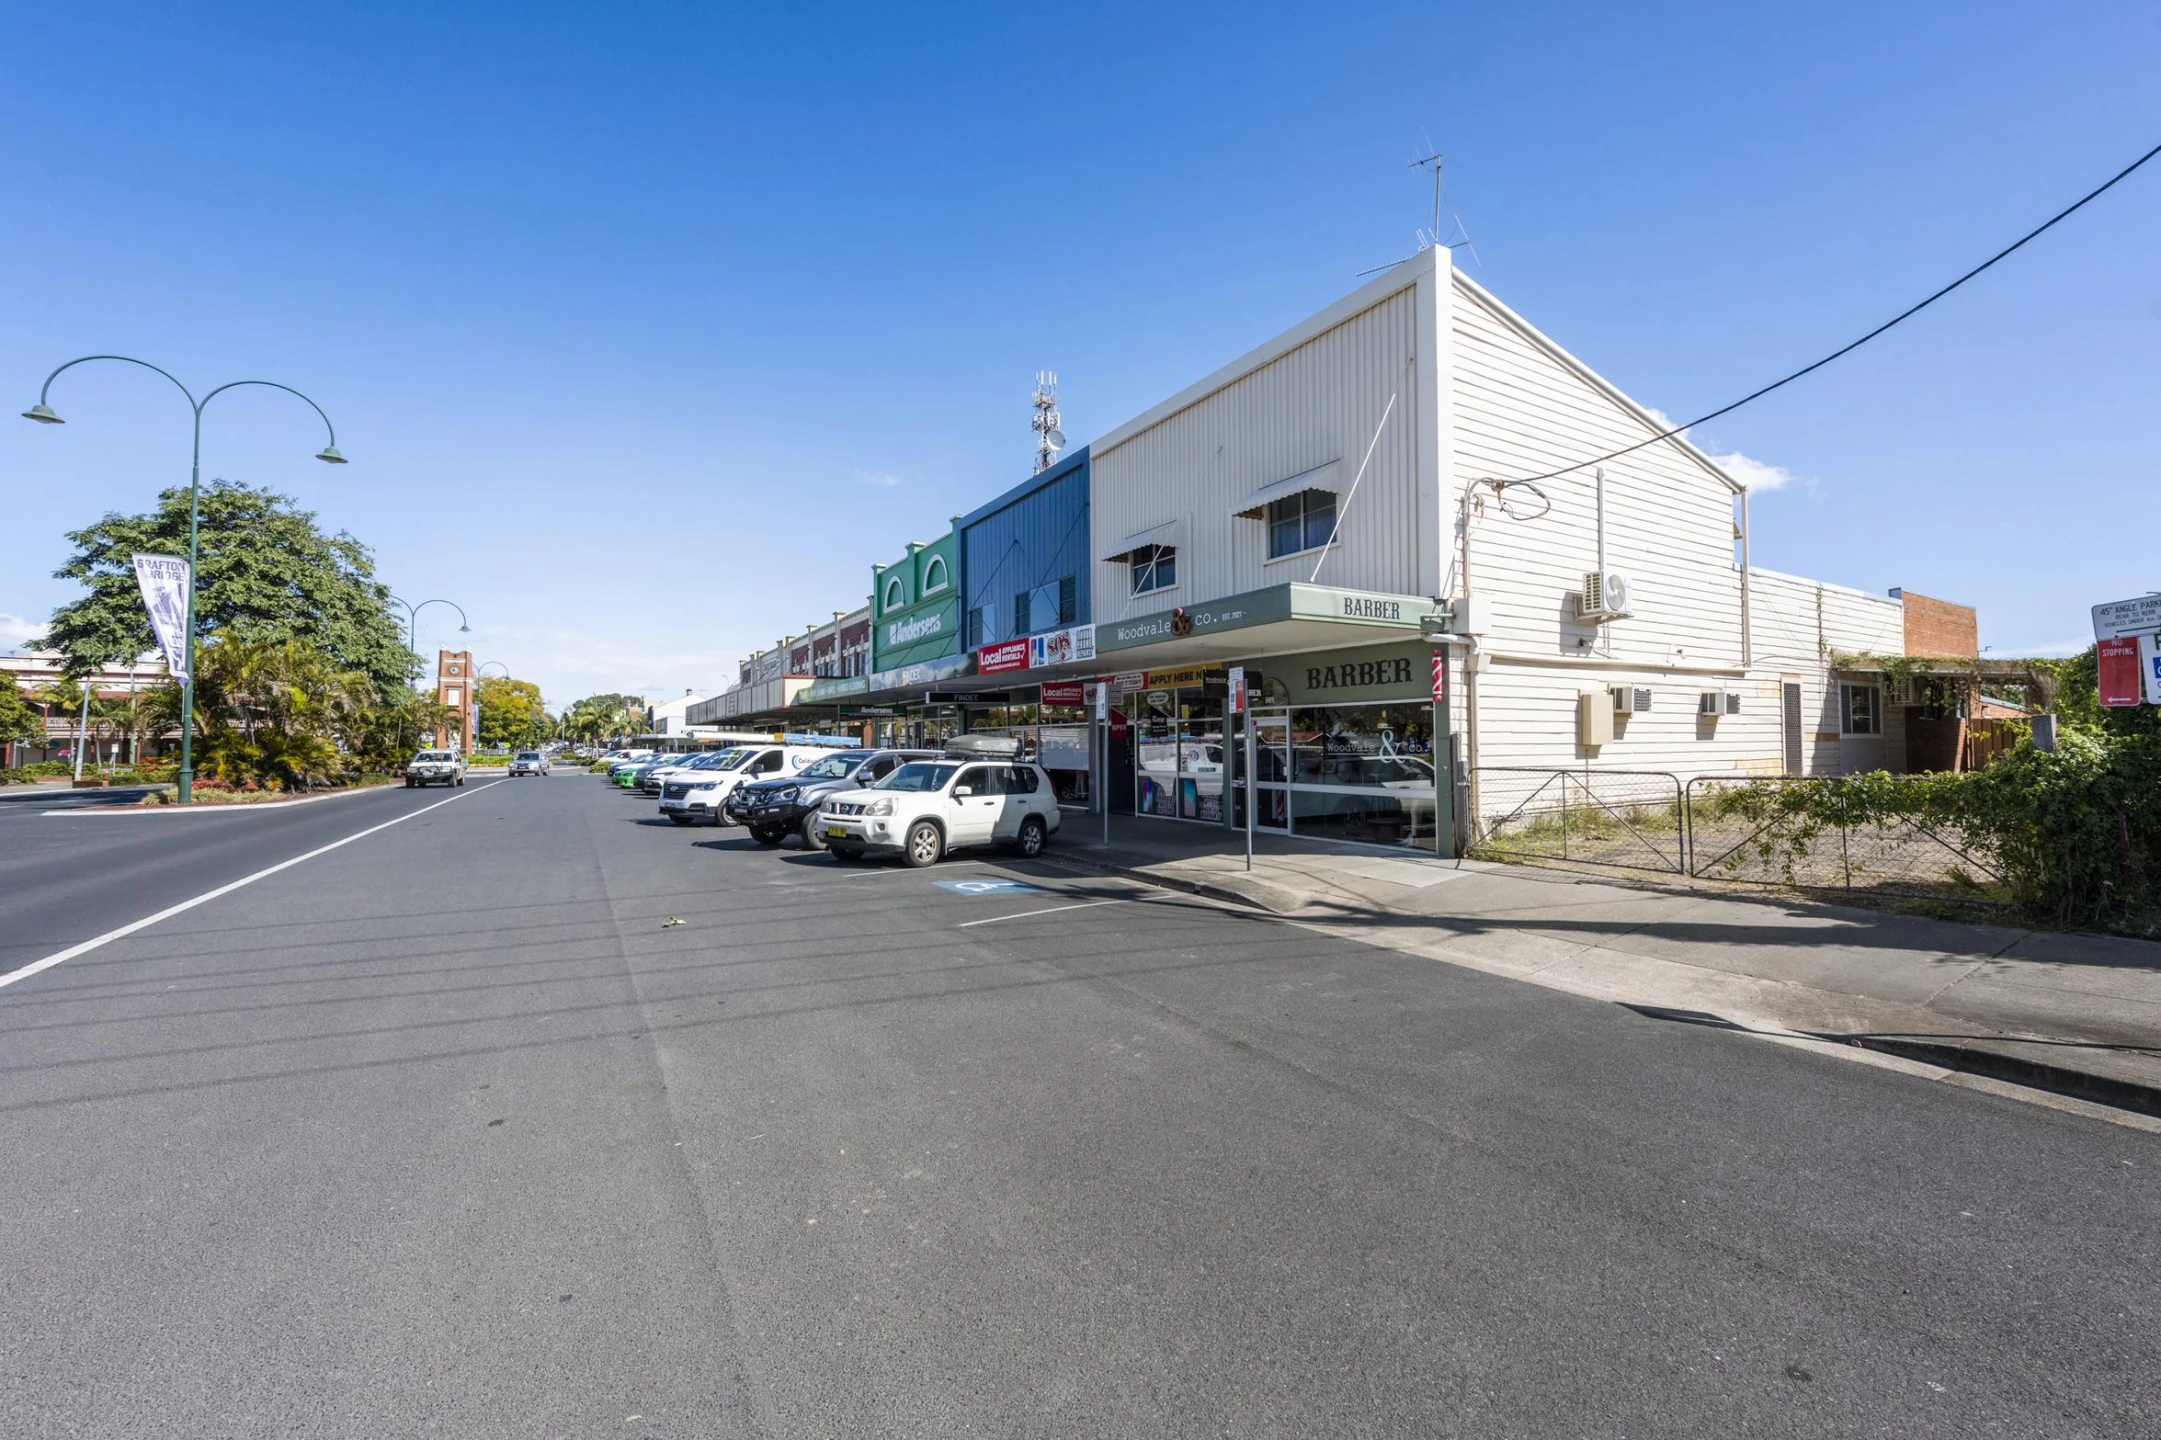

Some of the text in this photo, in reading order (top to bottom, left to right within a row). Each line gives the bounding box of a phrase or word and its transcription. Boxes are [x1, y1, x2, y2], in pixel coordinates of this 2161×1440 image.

[137, 559, 185, 572] GRAFTON
[1343, 597, 1400, 620] BARBER
[2115, 603, 2138, 614] ANGLE
[897, 614, 941, 644] Andersens
[1117, 619, 1171, 641] Woodvale
[1170, 607, 1192, 636] &
[2112, 638, 2123, 646] NO
[1002, 643, 1026, 654] APPLIANCE
[2102, 647, 2134, 657] STOPPING
[980, 647, 1001, 666] Local
[1002, 651, 1020, 662] RENTALS
[1149, 675, 1174, 685] APPLY
[1174, 672, 1195, 682] HERE
[1306, 657, 1413, 690] BARBER
[954, 693, 979, 702] FINDEX
[1043, 687, 1063, 697] Local
[861, 706, 893, 714] Andersens
[1327, 742, 1376, 752] Woodvale
[1379, 729, 1406, 764] &
